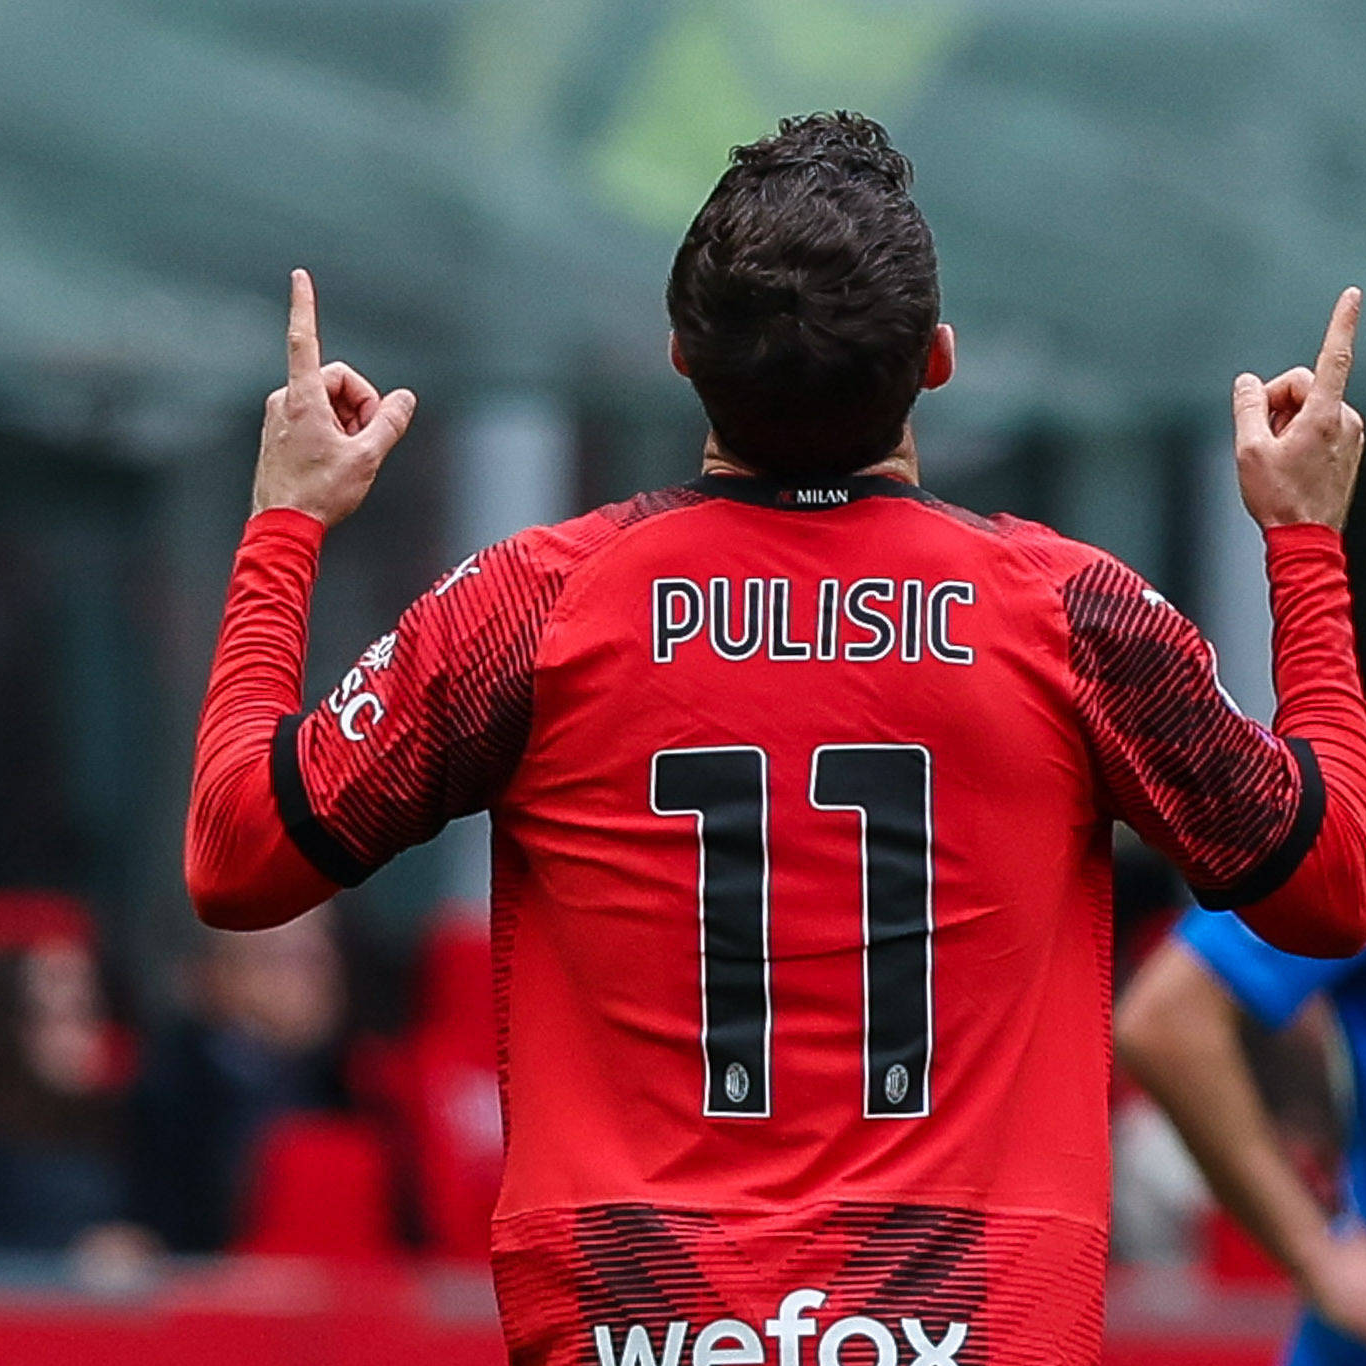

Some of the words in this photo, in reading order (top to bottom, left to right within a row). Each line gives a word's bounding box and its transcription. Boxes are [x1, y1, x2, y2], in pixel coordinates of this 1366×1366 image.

[796, 488, 849, 504] MILAN
[652, 577, 974, 665] PULISIC
[649, 742, 932, 1119] 11
